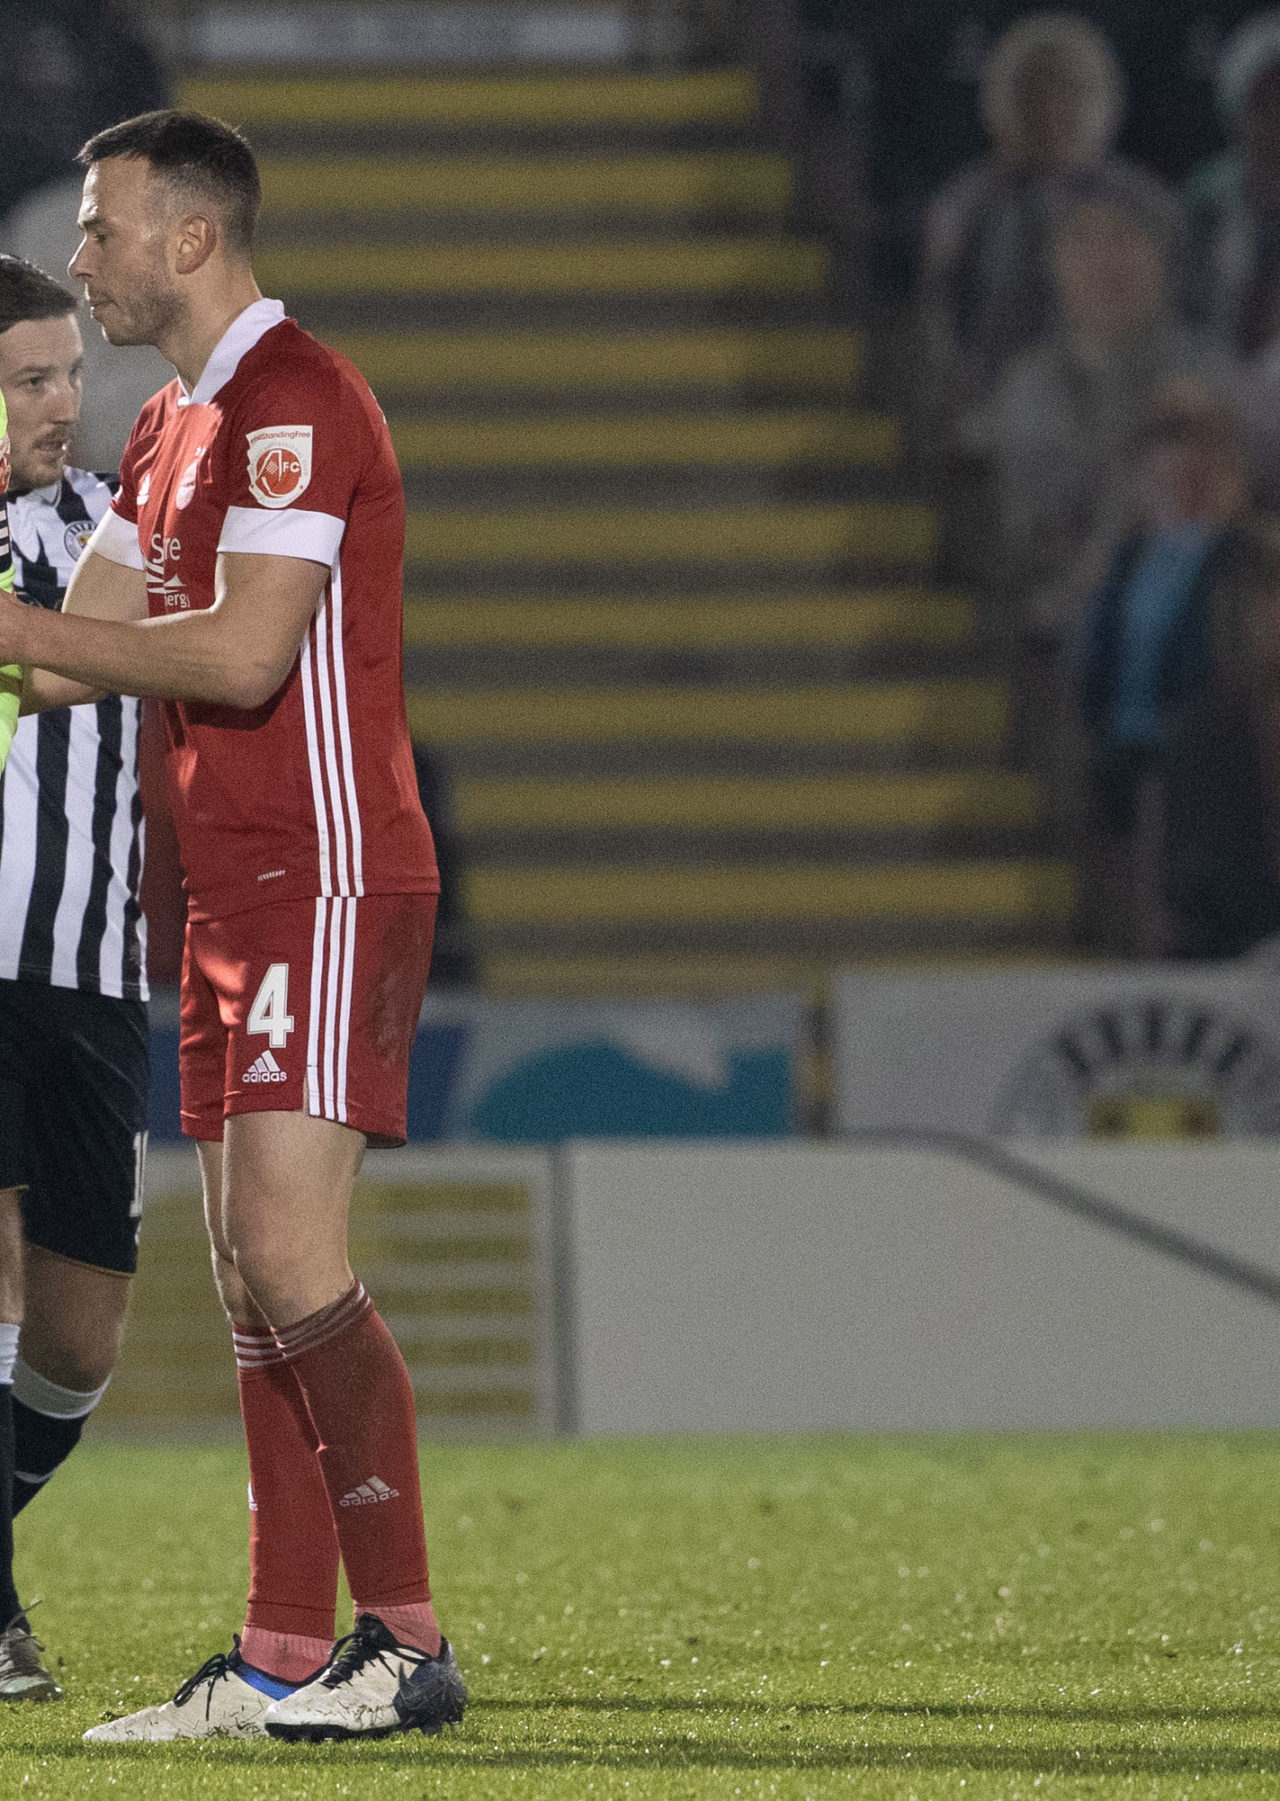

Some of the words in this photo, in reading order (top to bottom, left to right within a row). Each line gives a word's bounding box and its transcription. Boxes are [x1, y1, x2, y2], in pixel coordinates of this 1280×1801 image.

[247, 963, 294, 1048] 4
[242, 1068, 287, 1083] adidas
[339, 1488, 400, 1508] adidas
